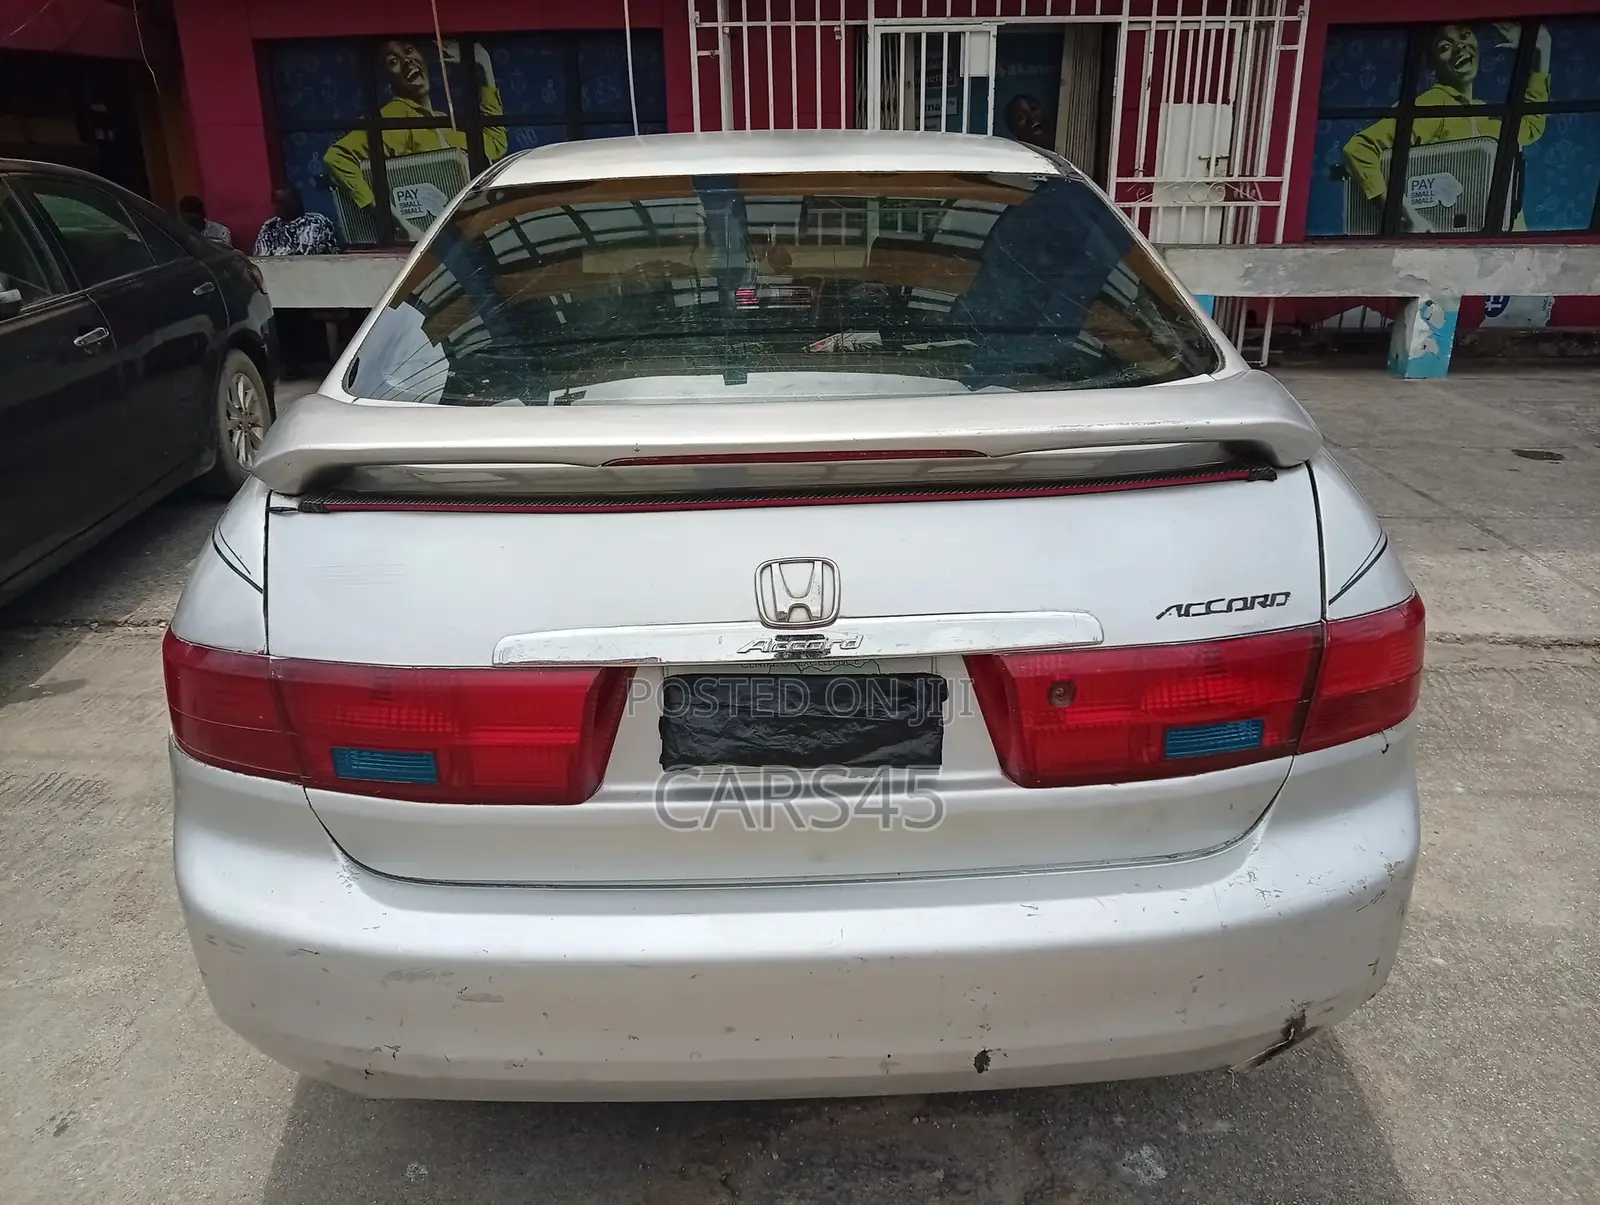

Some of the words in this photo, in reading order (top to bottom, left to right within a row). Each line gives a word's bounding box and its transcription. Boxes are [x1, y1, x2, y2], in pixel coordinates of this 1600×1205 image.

[1411, 177, 1436, 191] PAY
[396, 188, 419, 202] PAY
[1411, 190, 1435, 198] SMALL
[398, 200, 422, 209] SMALL
[1411, 197, 1435, 205] SMALL
[400, 207, 424, 215] SMALL
[1156, 591, 1291, 620] ACCORD
[737, 632, 864, 654] Accord
